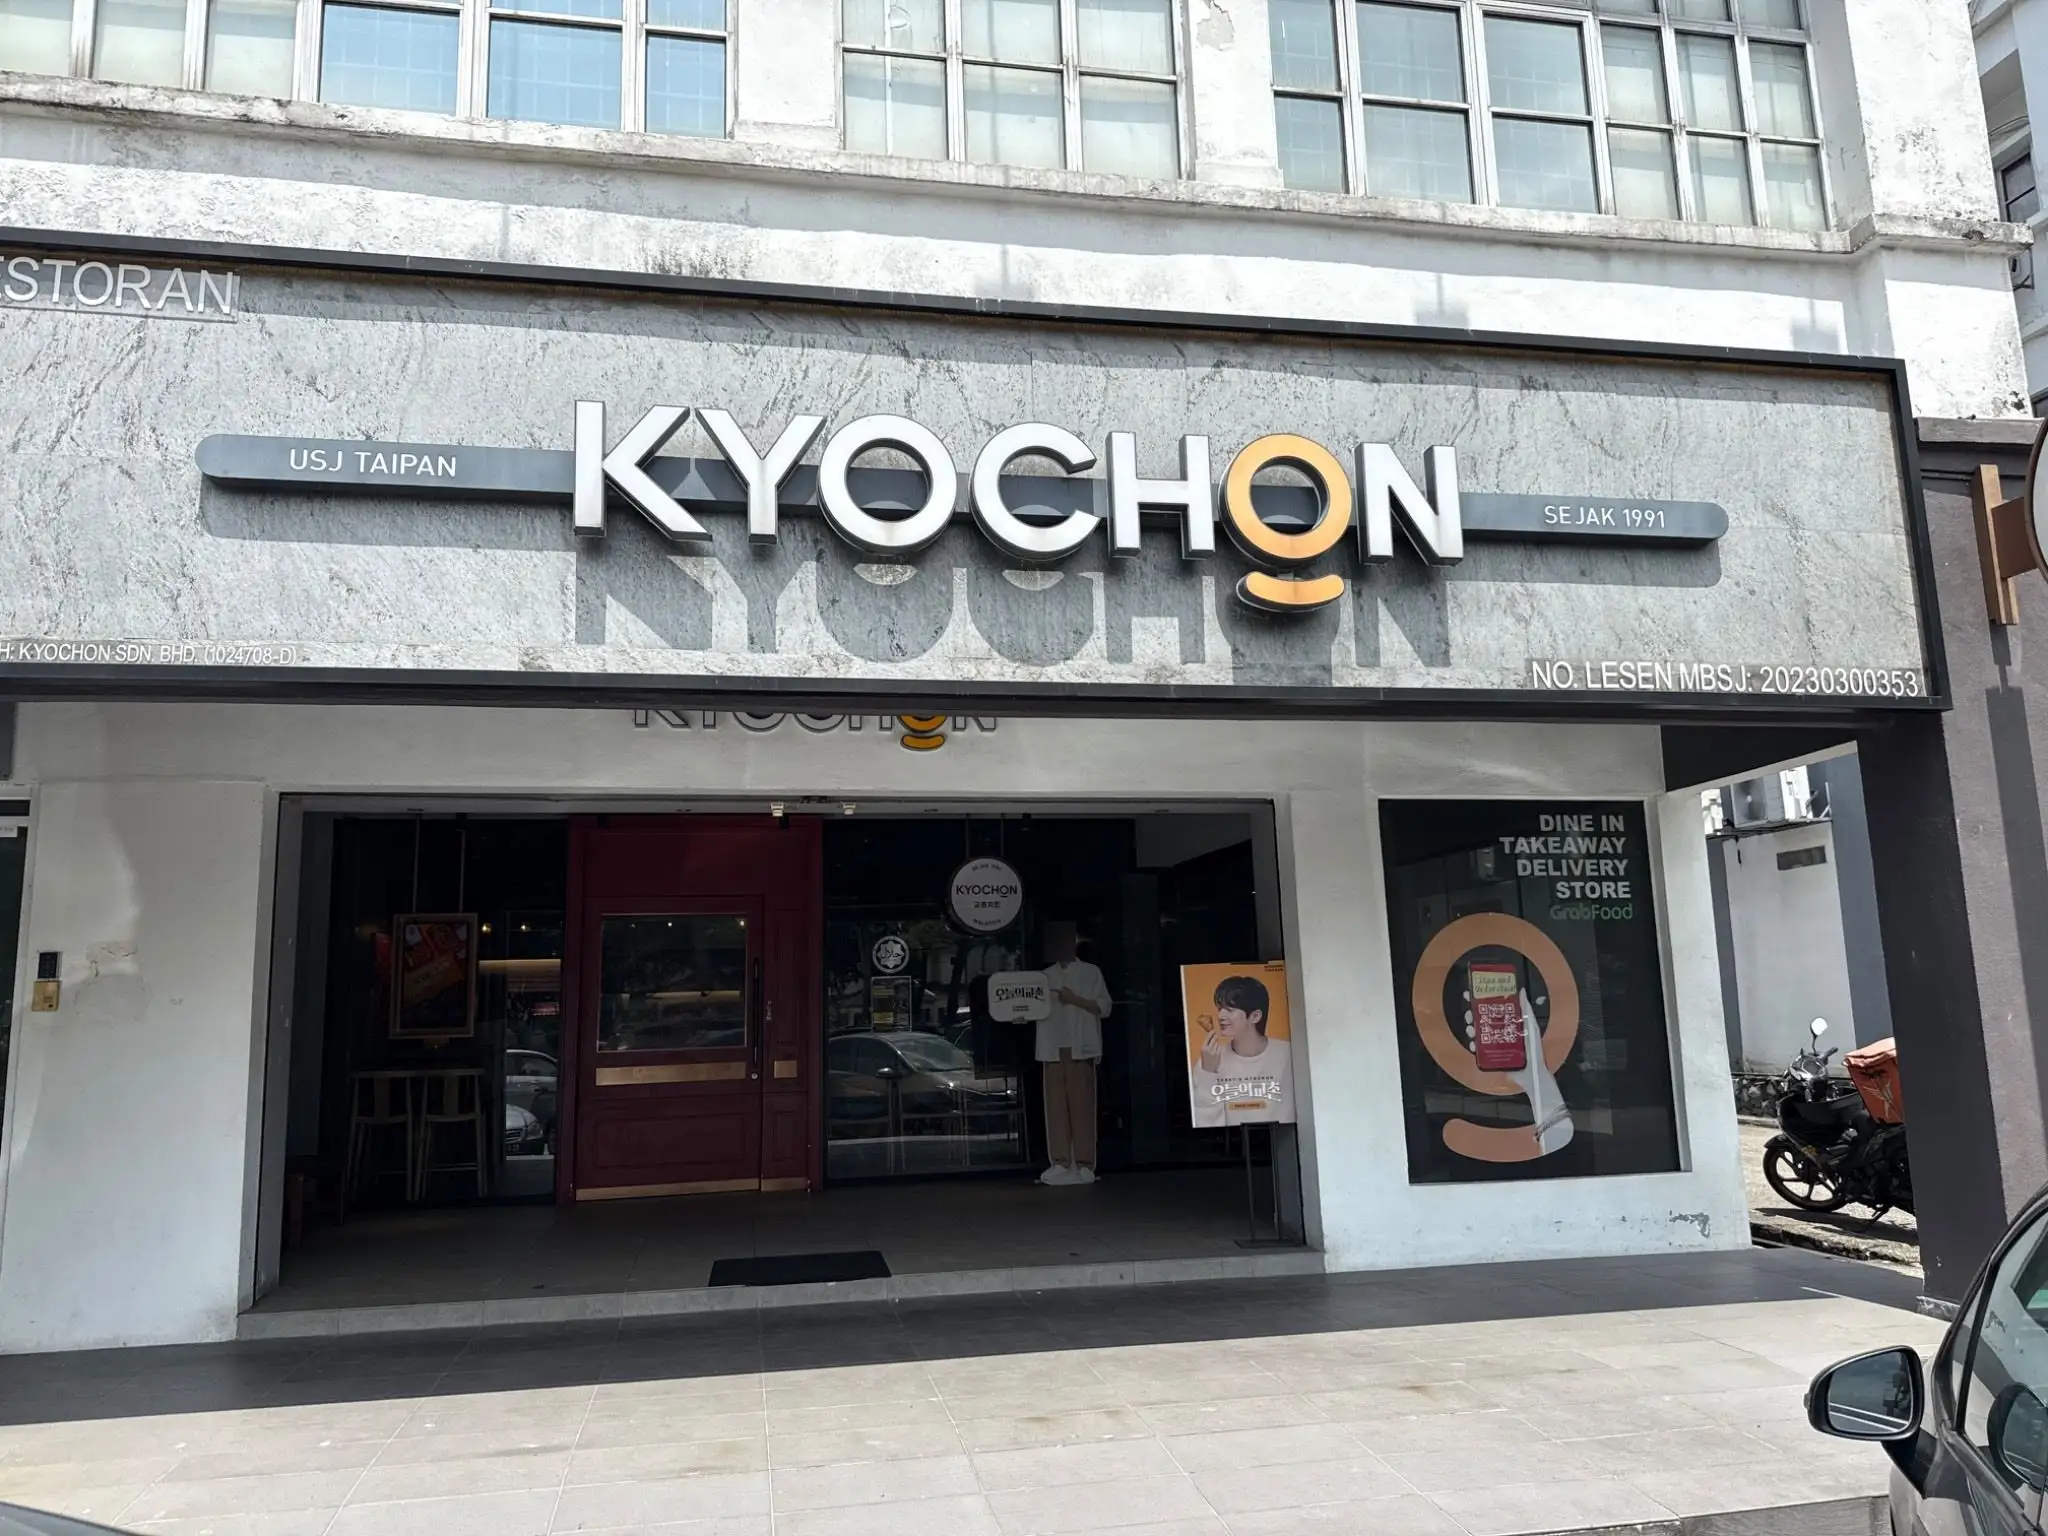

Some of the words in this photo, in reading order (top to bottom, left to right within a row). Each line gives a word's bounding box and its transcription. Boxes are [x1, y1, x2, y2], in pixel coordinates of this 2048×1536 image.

[0, 256, 234, 315] STORAN
[289, 449, 343, 471] USJ
[354, 451, 457, 477] TAIPAN
[572, 400, 1464, 611] KYOCHON
[1622, 508, 1665, 528] 1991
[19, 643, 110, 661] KYOCHON
[115, 644, 154, 663] SDN.
[160, 645, 197, 663] BHD.
[204, 646, 297, 665] (1024708-D)
[1531, 660, 1578, 689] NO.
[1585, 661, 1673, 689] LESEN
[1680, 662, 1753, 692] MBSJ:
[1759, 666, 1919, 697] 20230300353
[1539, 814, 1594, 832] DINE
[1601, 815, 1625, 832] IN
[1499, 836, 1627, 854] TAKEAWAY
[1516, 859, 1629, 876] DELIVERY
[956, 884, 1018, 898] KYOCHON
[1556, 881, 1632, 899] STORE
[1550, 903, 1633, 920] GrabFood
